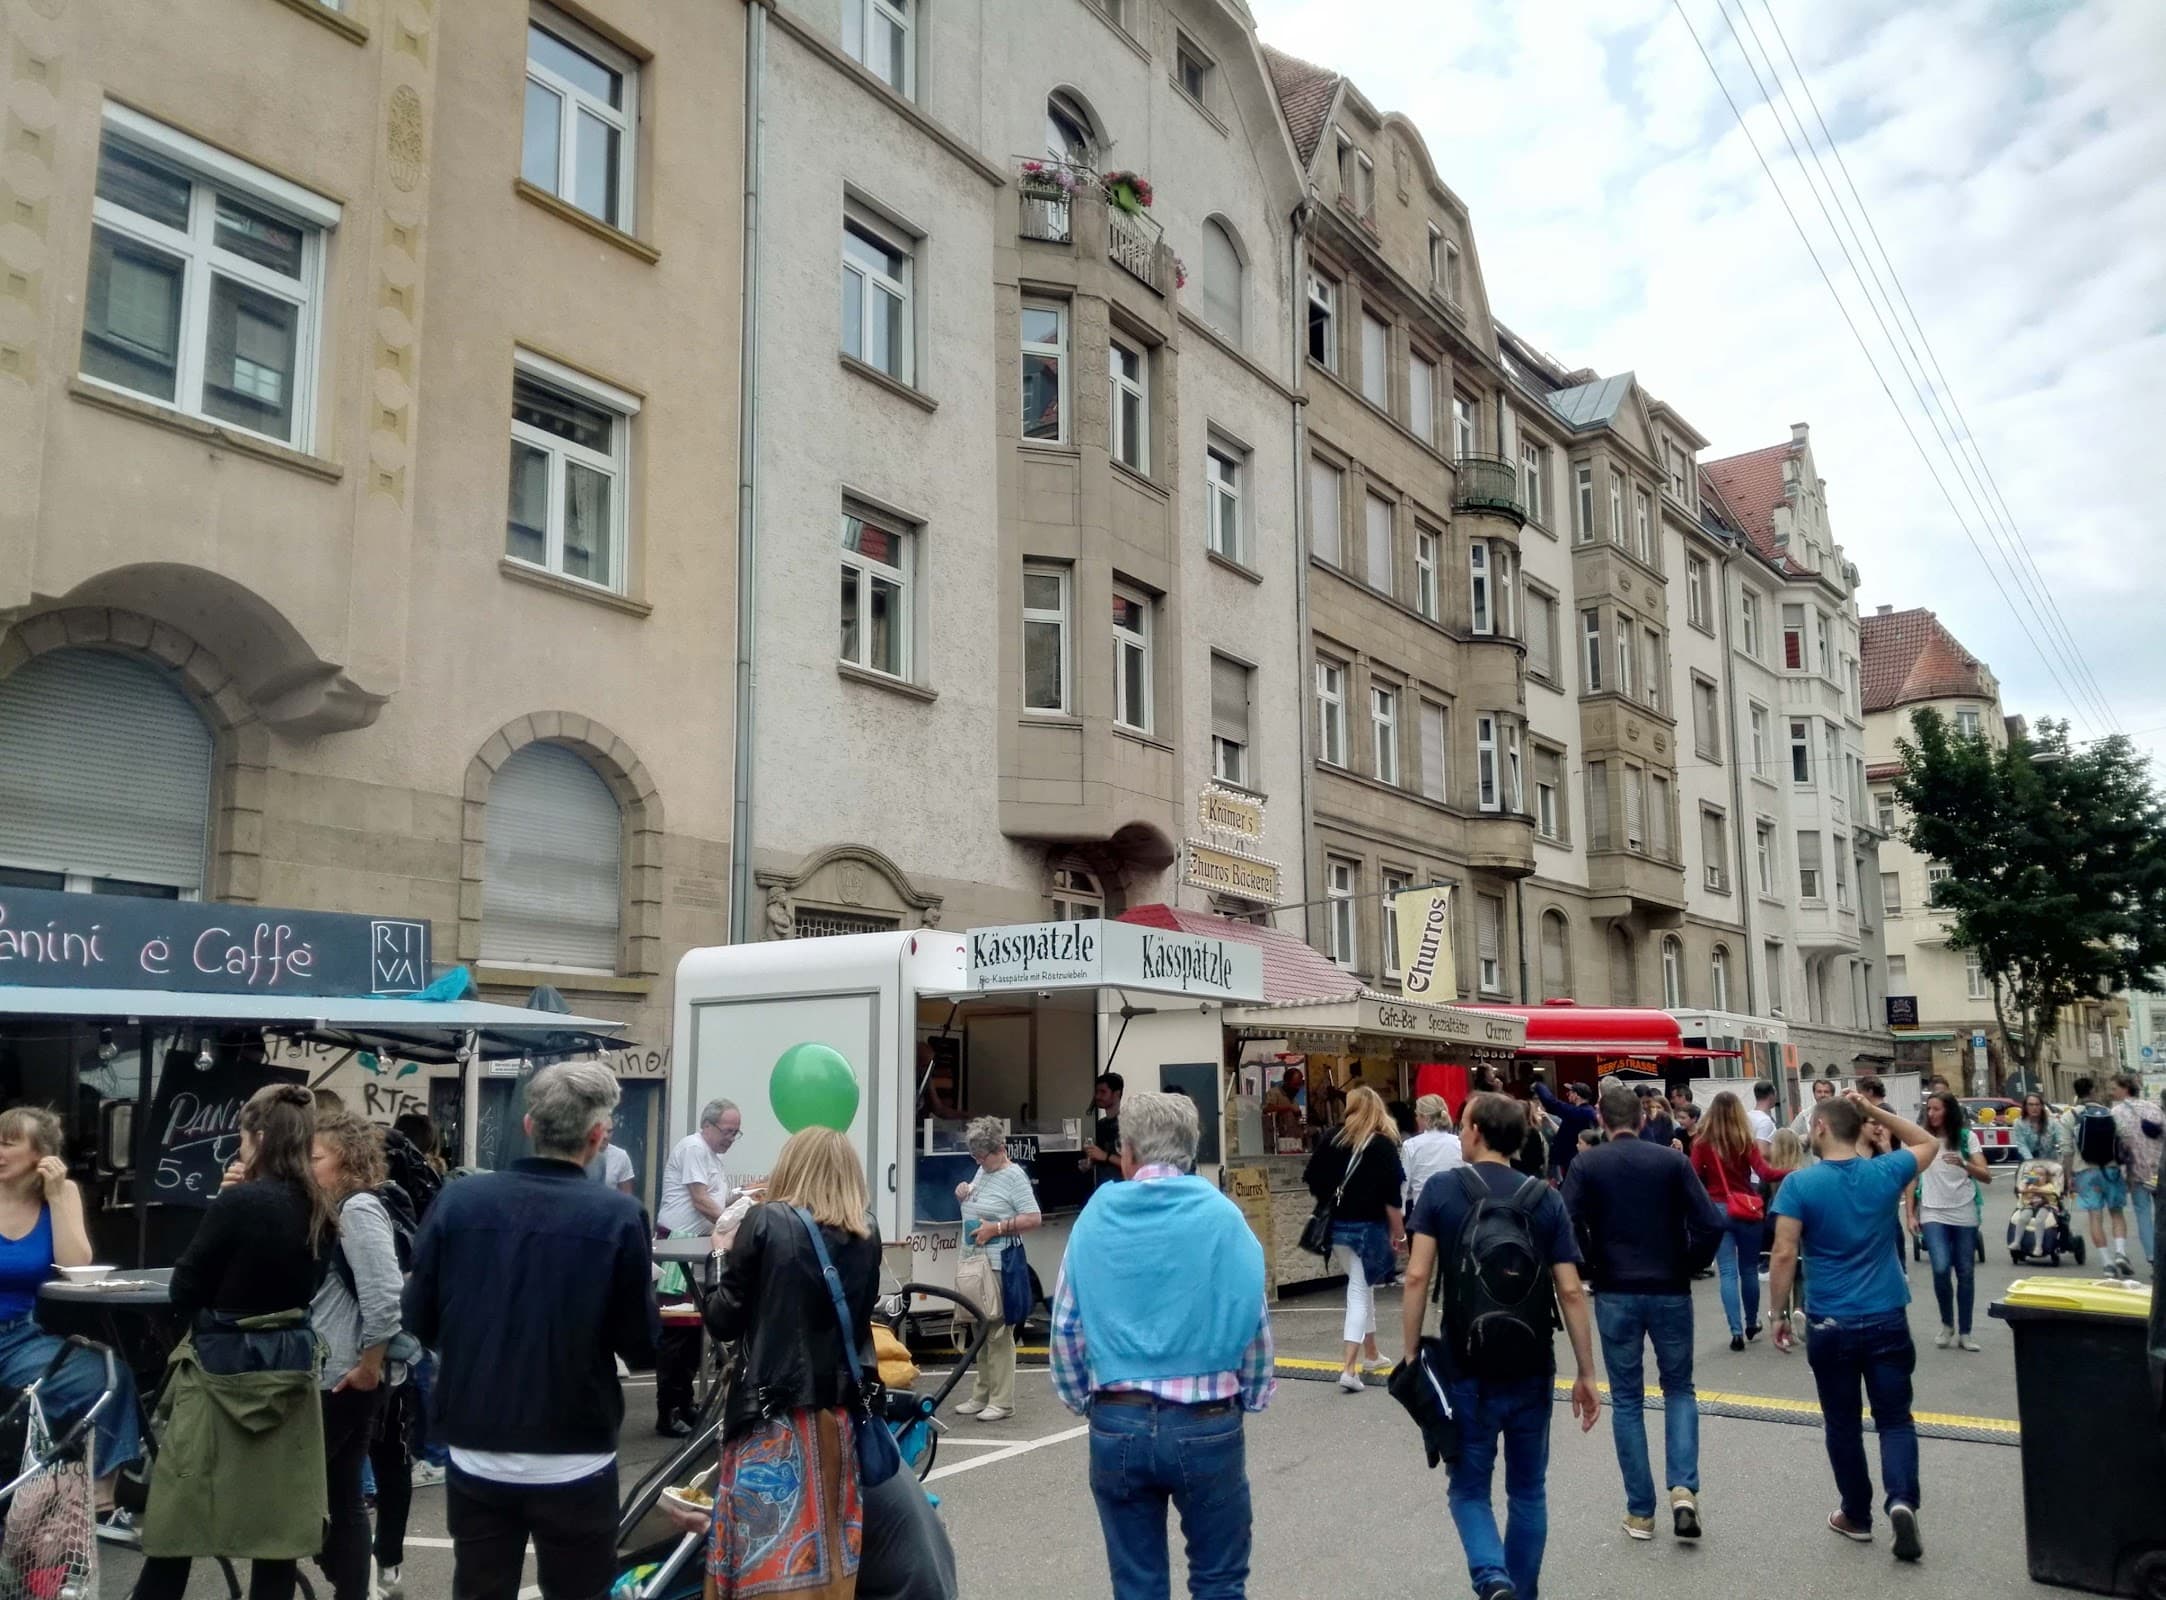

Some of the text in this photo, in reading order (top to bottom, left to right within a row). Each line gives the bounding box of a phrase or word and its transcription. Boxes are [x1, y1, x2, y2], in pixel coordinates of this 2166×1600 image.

[1208, 797, 1253, 832] Krämer's
[1232, 863, 1272, 893] Bäckerei
[0, 905, 104, 967] anini
[973, 922, 1094, 970] Kässpätzle
[1407, 898, 1447, 992] Churros
[1142, 934, 1232, 990] Kässpätzle
[1485, 1022, 1513, 1042] Churros
[1236, 1182, 1262, 1197] Churros
[931, 1232, 958, 1262] Grad
